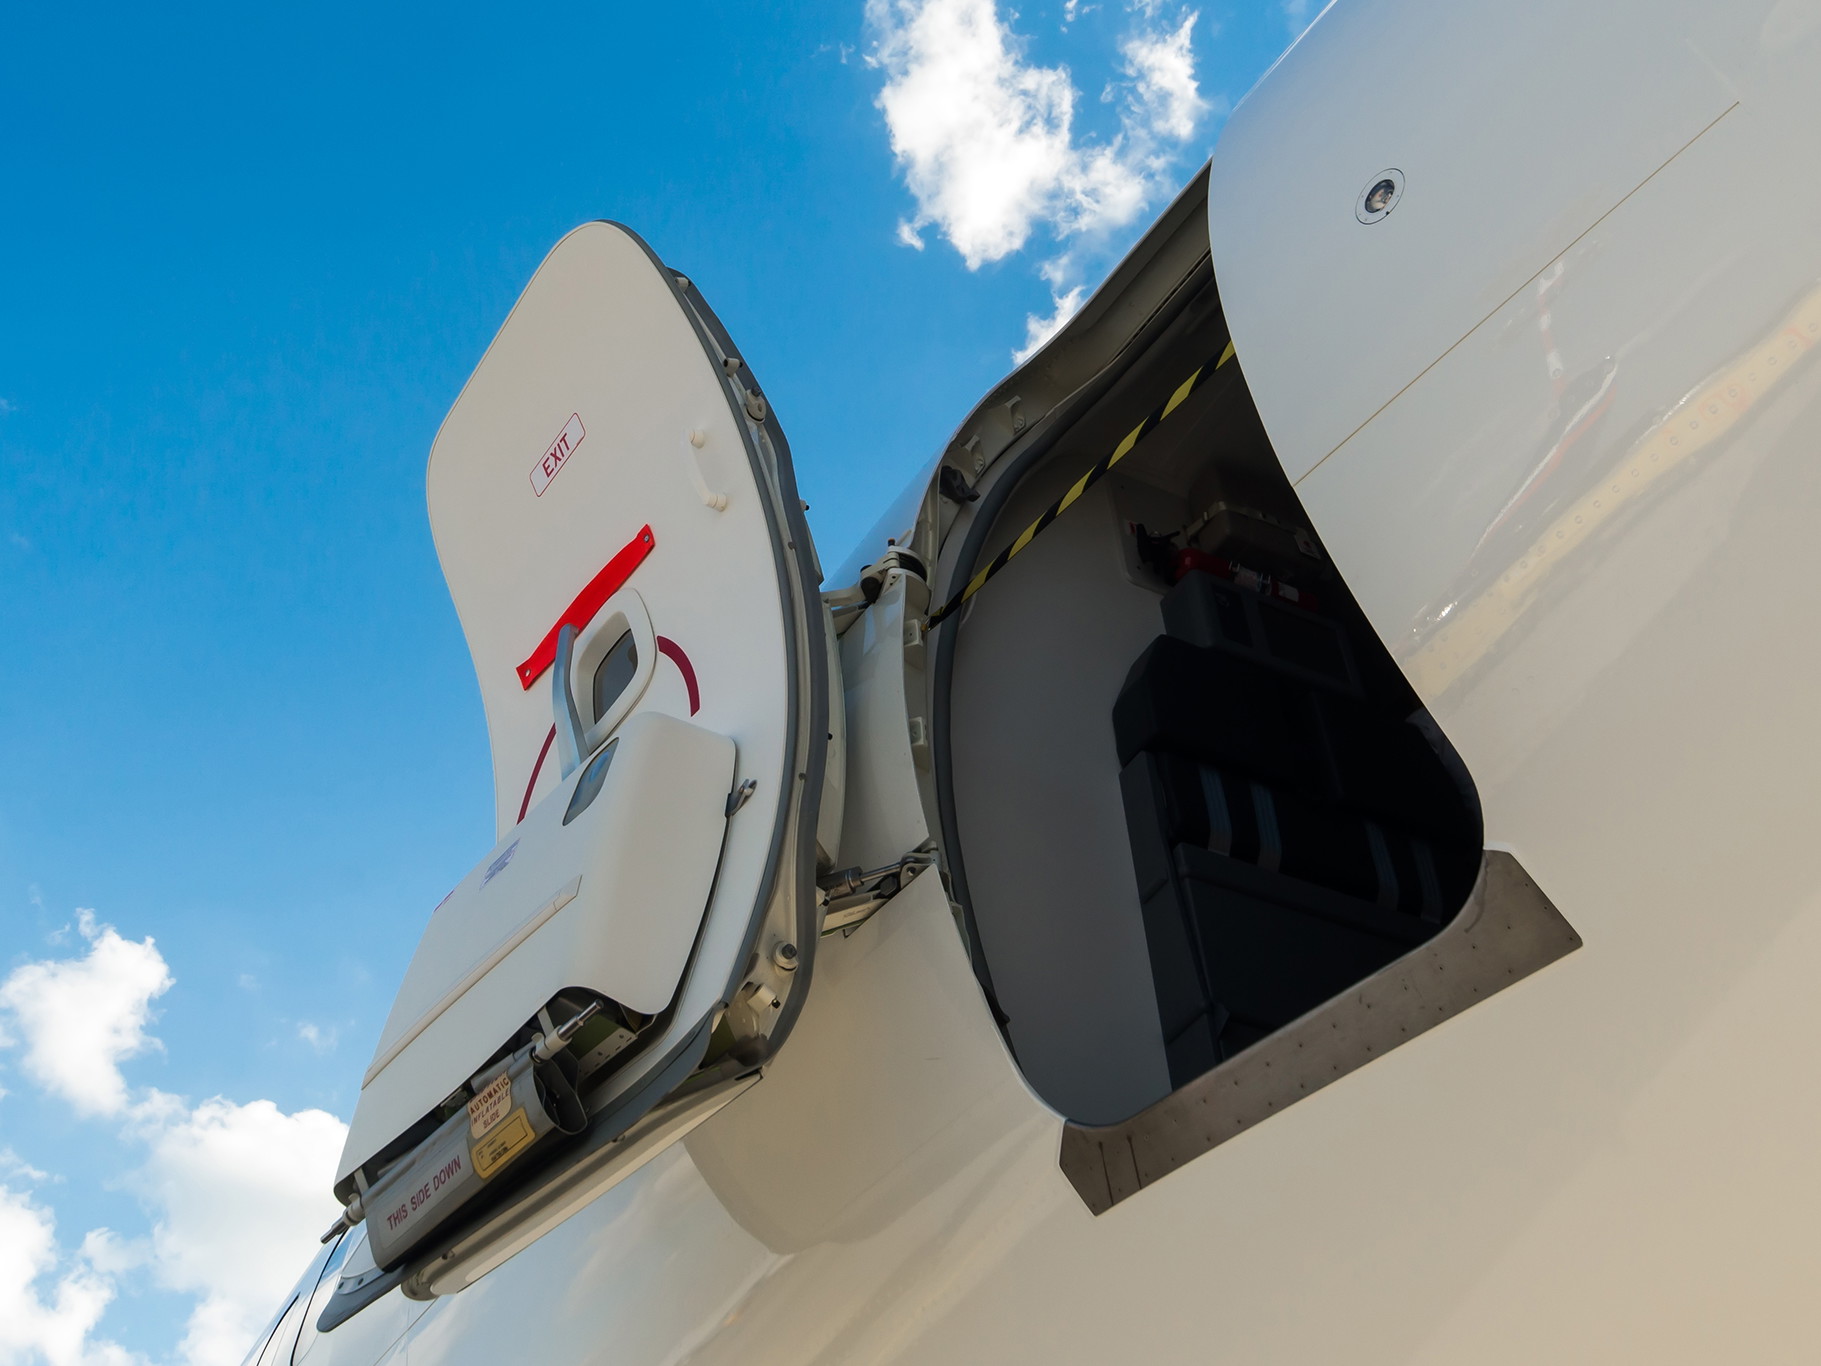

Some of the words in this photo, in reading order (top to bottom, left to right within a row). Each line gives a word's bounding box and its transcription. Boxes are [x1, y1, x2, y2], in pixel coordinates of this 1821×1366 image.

[542, 433, 570, 478] EXIT
[470, 1077, 509, 1114] AUTOMATIC
[471, 1088, 509, 1126] INFLATABLE
[482, 1109, 500, 1129] SLIDE
[387, 1204, 408, 1230] THIS
[410, 1182, 431, 1211] SIDE
[433, 1155, 461, 1191] DOWN
